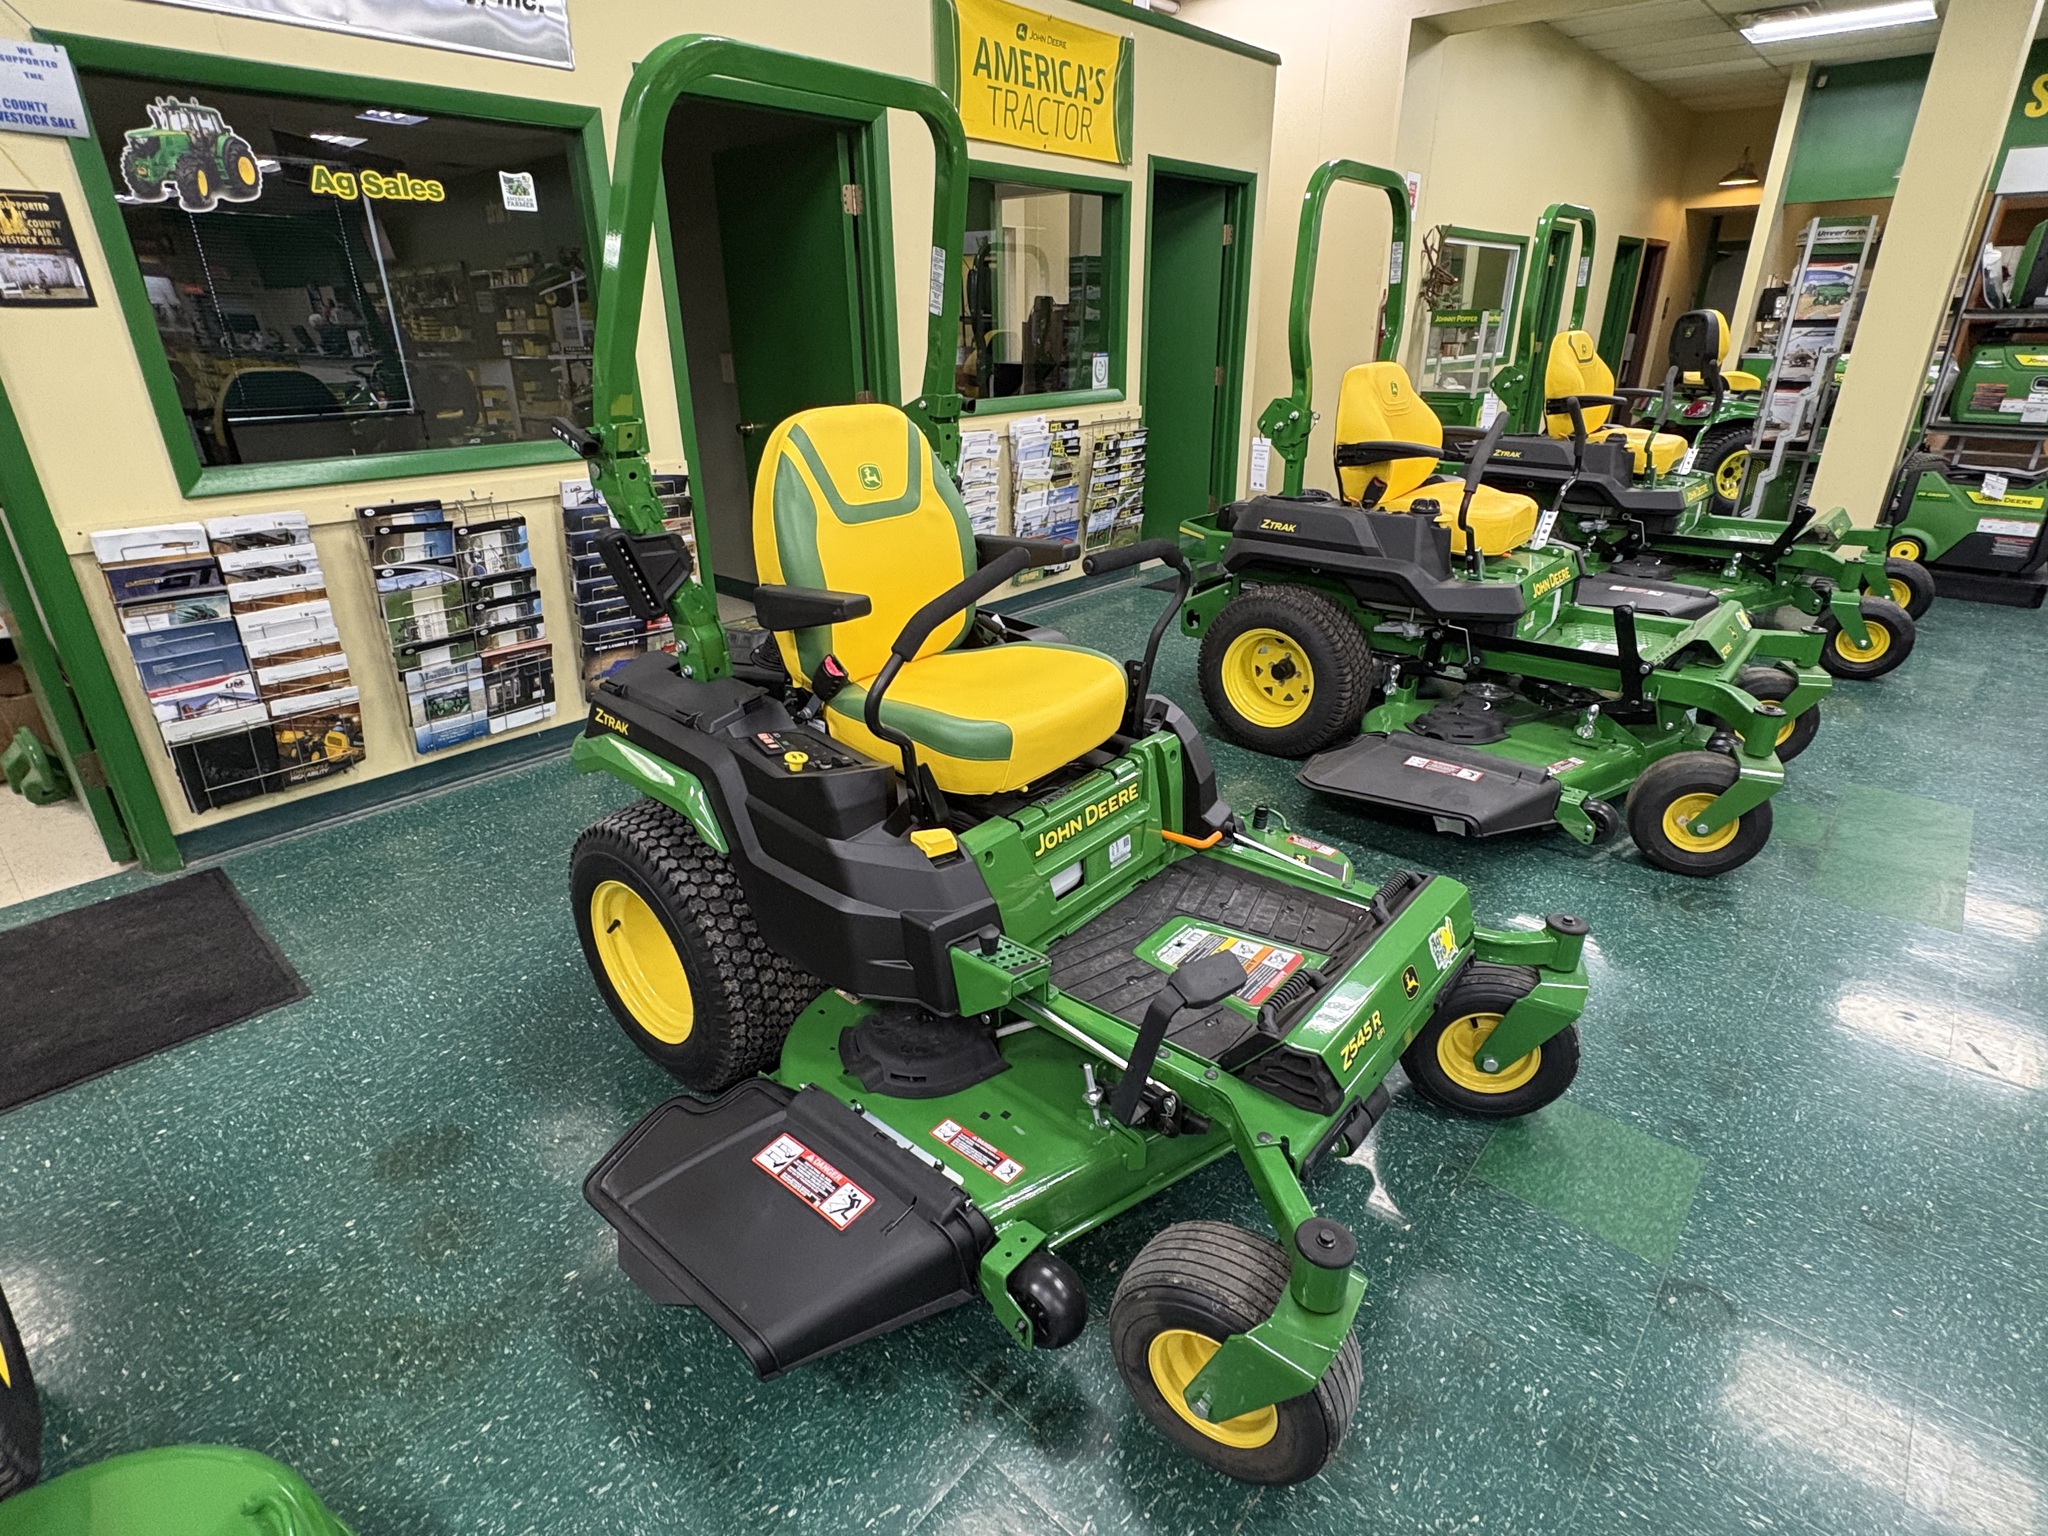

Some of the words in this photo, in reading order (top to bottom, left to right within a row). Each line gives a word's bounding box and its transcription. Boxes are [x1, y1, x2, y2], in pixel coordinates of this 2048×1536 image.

[1029, 30, 1047, 44] JOHN
[1047, 35, 1067, 49] DEERE
[16, 46, 34, 56] WE
[0, 54, 58, 69] SUPPORTED
[23, 71, 44, 81] THE
[972, 36, 1106, 105] AMERICA'S
[2, 97, 48, 113] COUNTY
[987, 85, 1093, 144] TRACTOR
[50, 116, 78, 129] SALE
[311, 165, 358, 200] Ag
[360, 170, 445, 202] Sales
[27, 220, 61, 229] COUNTY
[41, 236, 62, 245] SALE
[1493, 449, 1521, 458] ZTRAK
[2003, 497, 2034, 505] DEERE
[1260, 518, 1297, 532] ZTRAK
[1532, 578, 1550, 599] JOHN
[1549, 566, 1571, 588] DEERE
[595, 707, 629, 736] ZTRAK
[1035, 815, 1083, 857] JOHN
[1084, 783, 1139, 827] DEERE
[812, 1153, 844, 1182] DANGER
